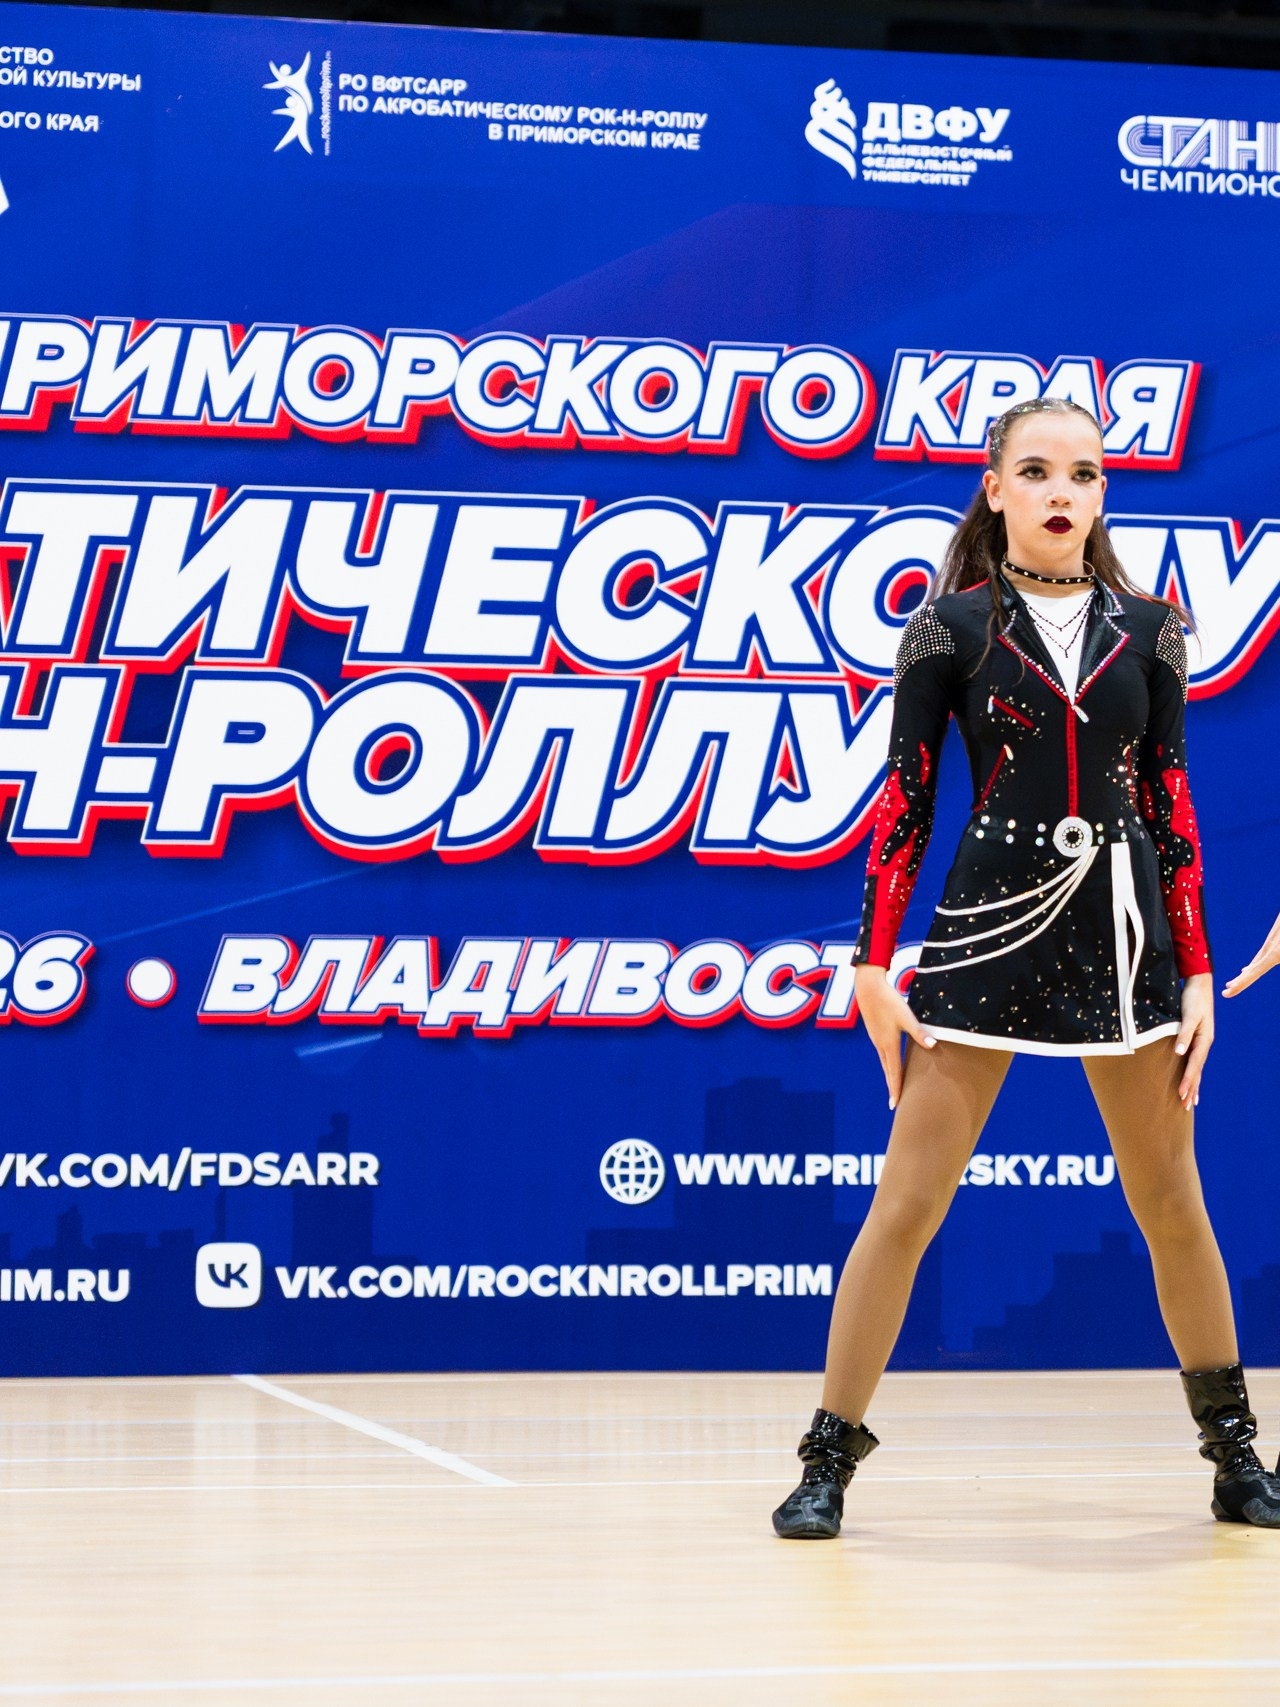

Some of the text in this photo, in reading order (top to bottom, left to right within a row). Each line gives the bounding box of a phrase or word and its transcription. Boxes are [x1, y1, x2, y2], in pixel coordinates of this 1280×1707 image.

[0, 46, 54, 66] СТВО
[0, 65, 142, 92] ОЙ КУЛЬТУРЫ
[338, 73, 468, 96] РО ВФТСАРР
[0, 111, 99, 132] ОГО КРАЯ
[338, 94, 708, 129] ПО АКРОБАТИЧЕСКОМУ РОК-Н-РОЛЛУ
[861, 101, 1011, 143] ДВФУ
[488, 123, 701, 150] В ПРИМОРСКОМ КРАЕ
[861, 143, 1014, 162] ДАЛЬНЕВОСТОЧНЫЙ
[861, 156, 978, 173] ФЕДЕРАЛЬНЫЙ
[861, 169, 972, 187] УНИВЕРСИТЕТ
[0, 930, 922, 1037] 6 ВЛАДИВОСТ
[673, 1153, 1116, 1187] WWW.PRISKY.RU
[0, 1268, 130, 1302] IM.RU
[275, 1264, 832, 1299] VK.COM/ROCKNROLLPRIM
